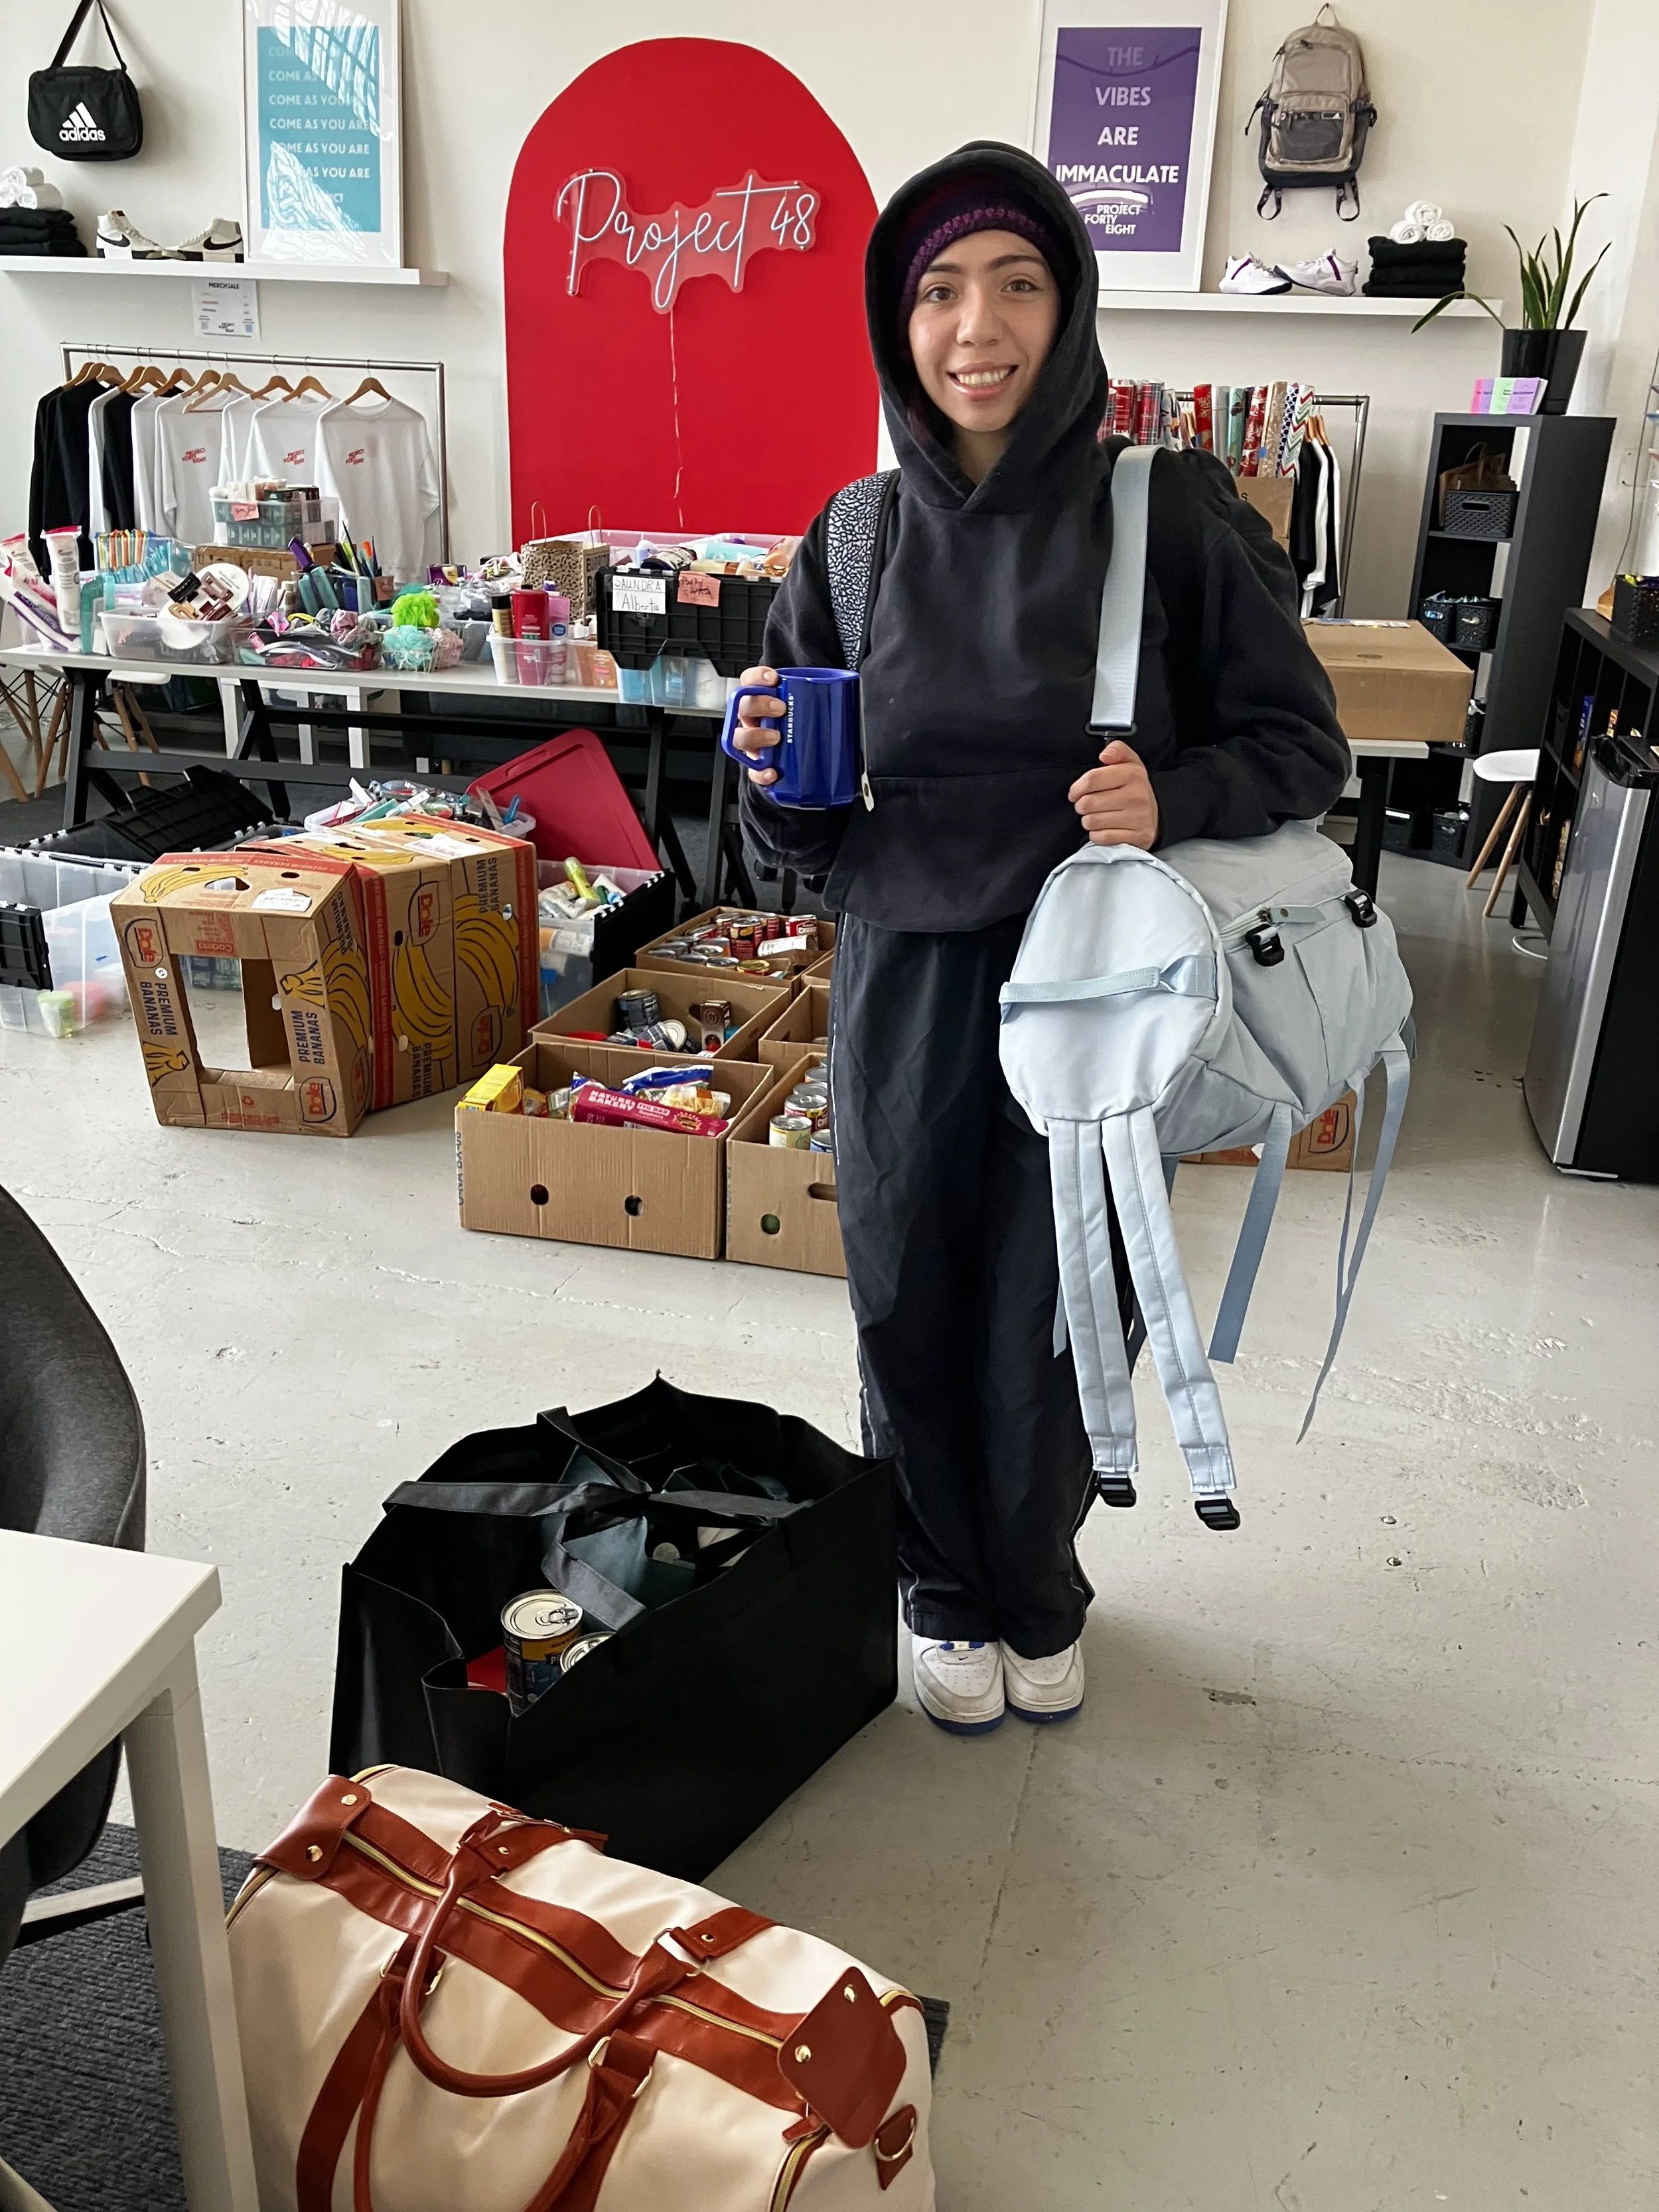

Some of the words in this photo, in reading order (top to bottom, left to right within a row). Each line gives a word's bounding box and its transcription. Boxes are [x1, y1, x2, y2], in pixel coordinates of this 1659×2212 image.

[1108, 47, 1143, 66] THE
[268, 70, 300, 81] COME
[269, 94, 301, 106] COME
[304, 95, 317, 106] AS
[1096, 87, 1151, 106] VIBES
[269, 118, 302, 129] COME
[305, 118, 319, 129] AS
[321, 119, 346, 129] YOU
[348, 119, 370, 130] ARE
[59, 127, 106, 141] adidas
[1098, 126, 1139, 145] ARE
[305, 143, 319, 153] AS
[321, 143, 346, 154] YOU
[348, 143, 370, 154] ARE
[322, 167, 346, 179] YOU
[348, 167, 370, 179] ARE
[1056, 165, 1179, 183] IMMACULATE
[1084, 213, 1118, 224] FORTY
[1097, 202, 1141, 216] PROJECT
[1105, 224, 1136, 234] EIGHT
[557, 173, 800, 307] Project
[771, 194, 816, 245] 48
[614, 578, 662, 592] SAUNDRA
[622, 593, 660, 612] Alberta
[477, 859, 489, 913] PREMIUM
[488, 857, 499, 911] BANANAS
[419, 893, 434, 936] Dole
[137, 928, 158, 962] Dole
[140, 982, 162, 1035] BANANAS
[155, 983, 178, 1035] PREMIUM
[291, 1011, 311, 1063] PREMIUM
[306, 1011, 325, 1065] BANANAS
[306, 1082, 324, 1115] Dole
[588, 1096, 636, 1111] BAKERY
[1317, 1109, 1337, 1145] Dole
